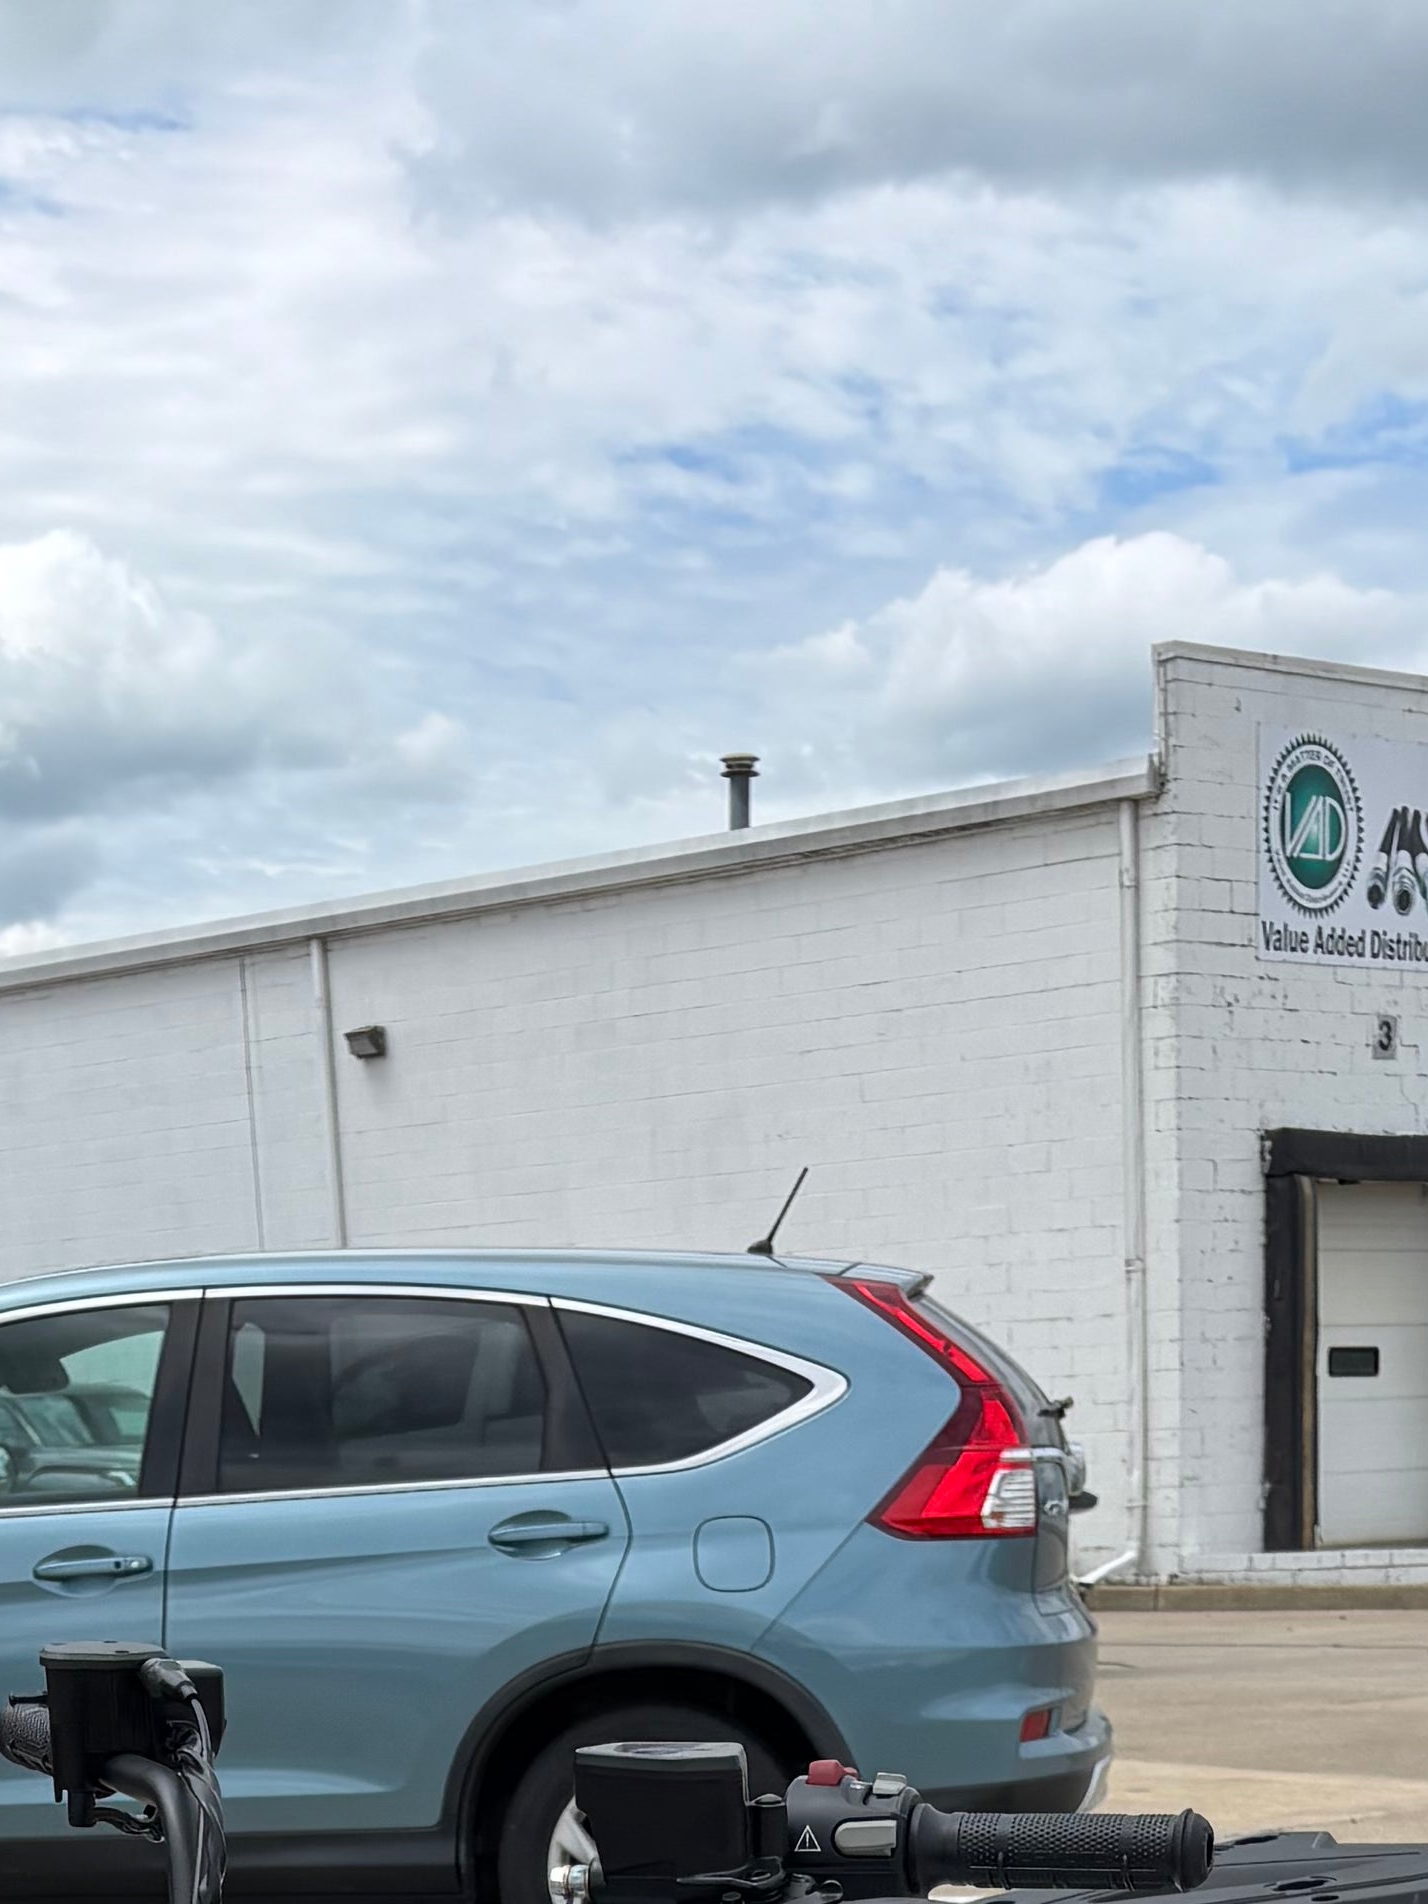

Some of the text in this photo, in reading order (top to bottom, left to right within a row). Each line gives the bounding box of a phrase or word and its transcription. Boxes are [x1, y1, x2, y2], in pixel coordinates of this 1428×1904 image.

[1261, 920, 1310, 954] Value
[1313, 924, 1367, 959] Added
[1376, 1020, 1393, 1052] 3
